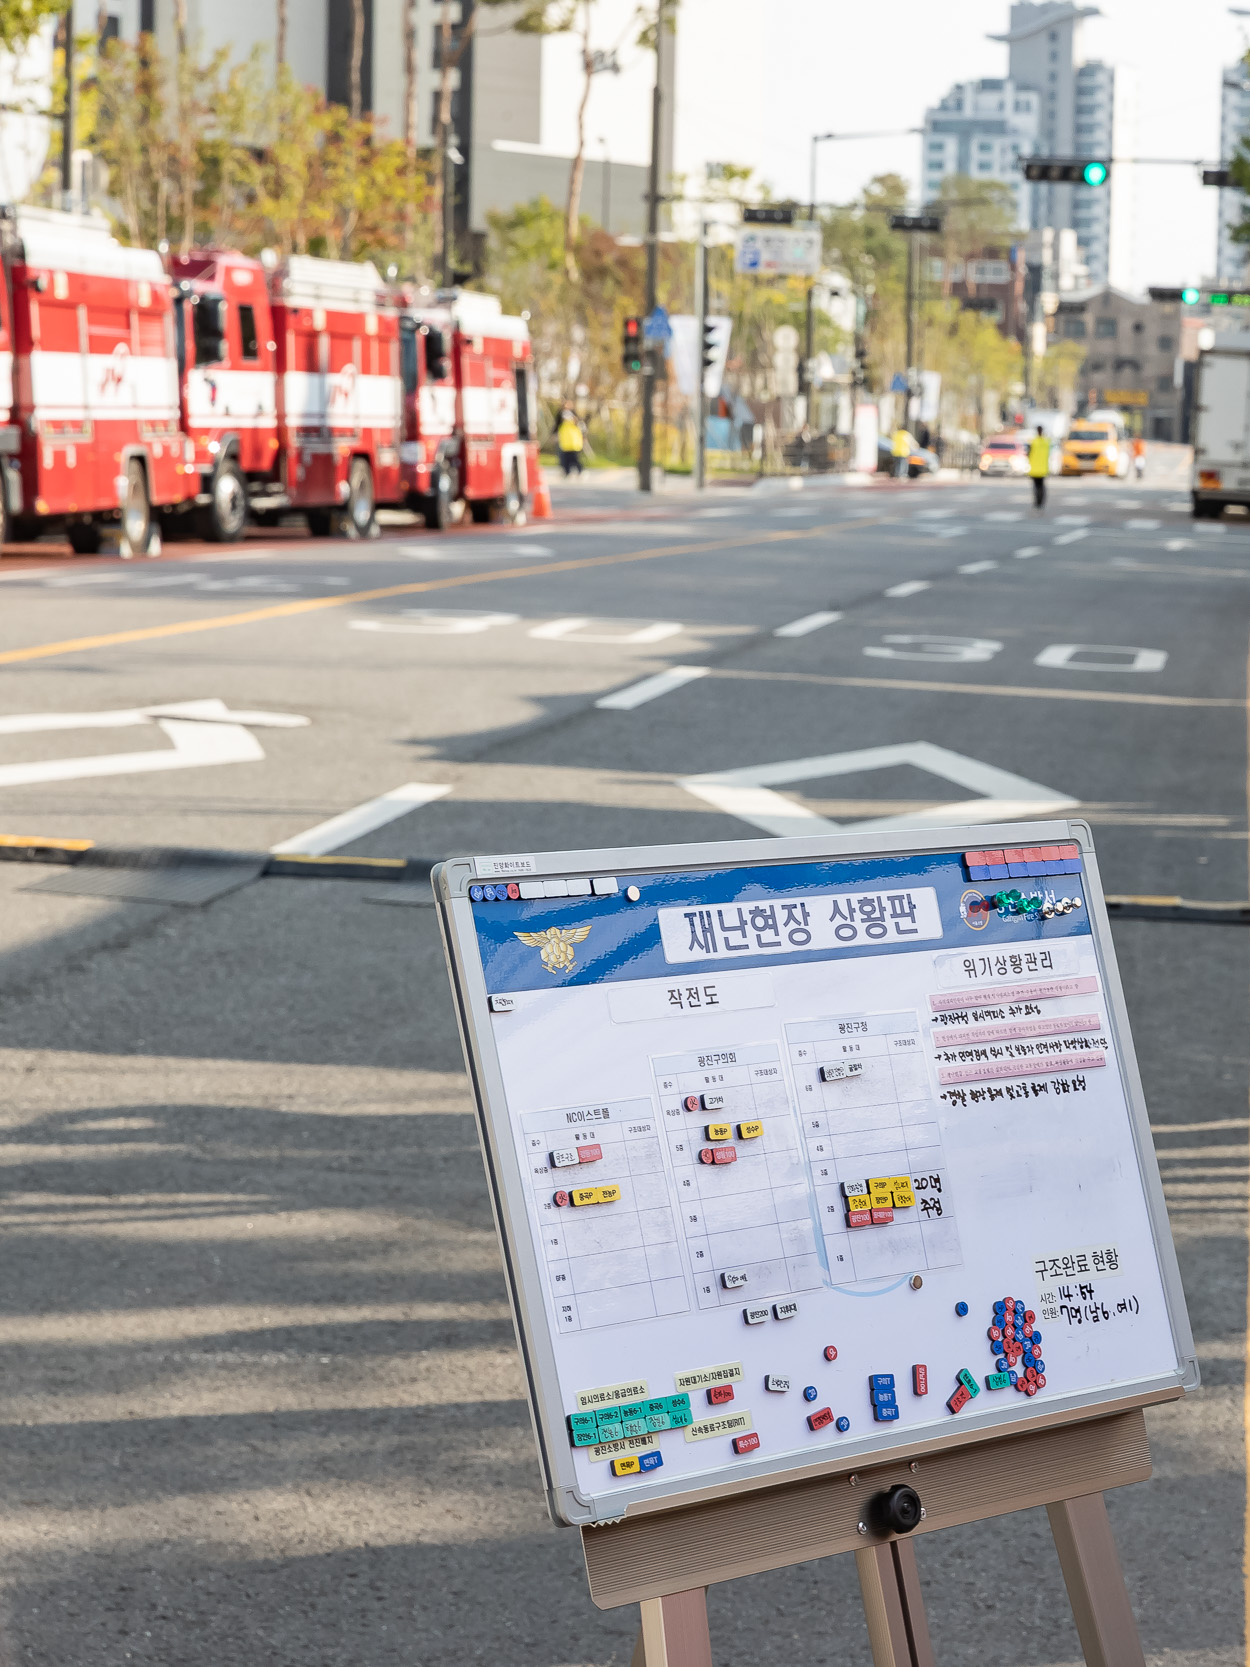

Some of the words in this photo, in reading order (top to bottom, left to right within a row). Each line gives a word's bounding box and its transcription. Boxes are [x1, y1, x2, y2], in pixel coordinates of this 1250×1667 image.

[684, 902, 813, 955] 재난현장
[828, 892, 920, 941] 상황판
[963, 950, 1054, 979] 위기상황관리
[667, 985, 721, 1010] 작전도
[838, 1021, 868, 1033] 광진구청
[697, 1052, 738, 1067] 광진구의회
[1034, 1254, 1091, 1282] 구조완료
[1091, 1247, 1119, 1272] 현황
[580, 1386, 646, 1407] 임시의료소/응급의료소
